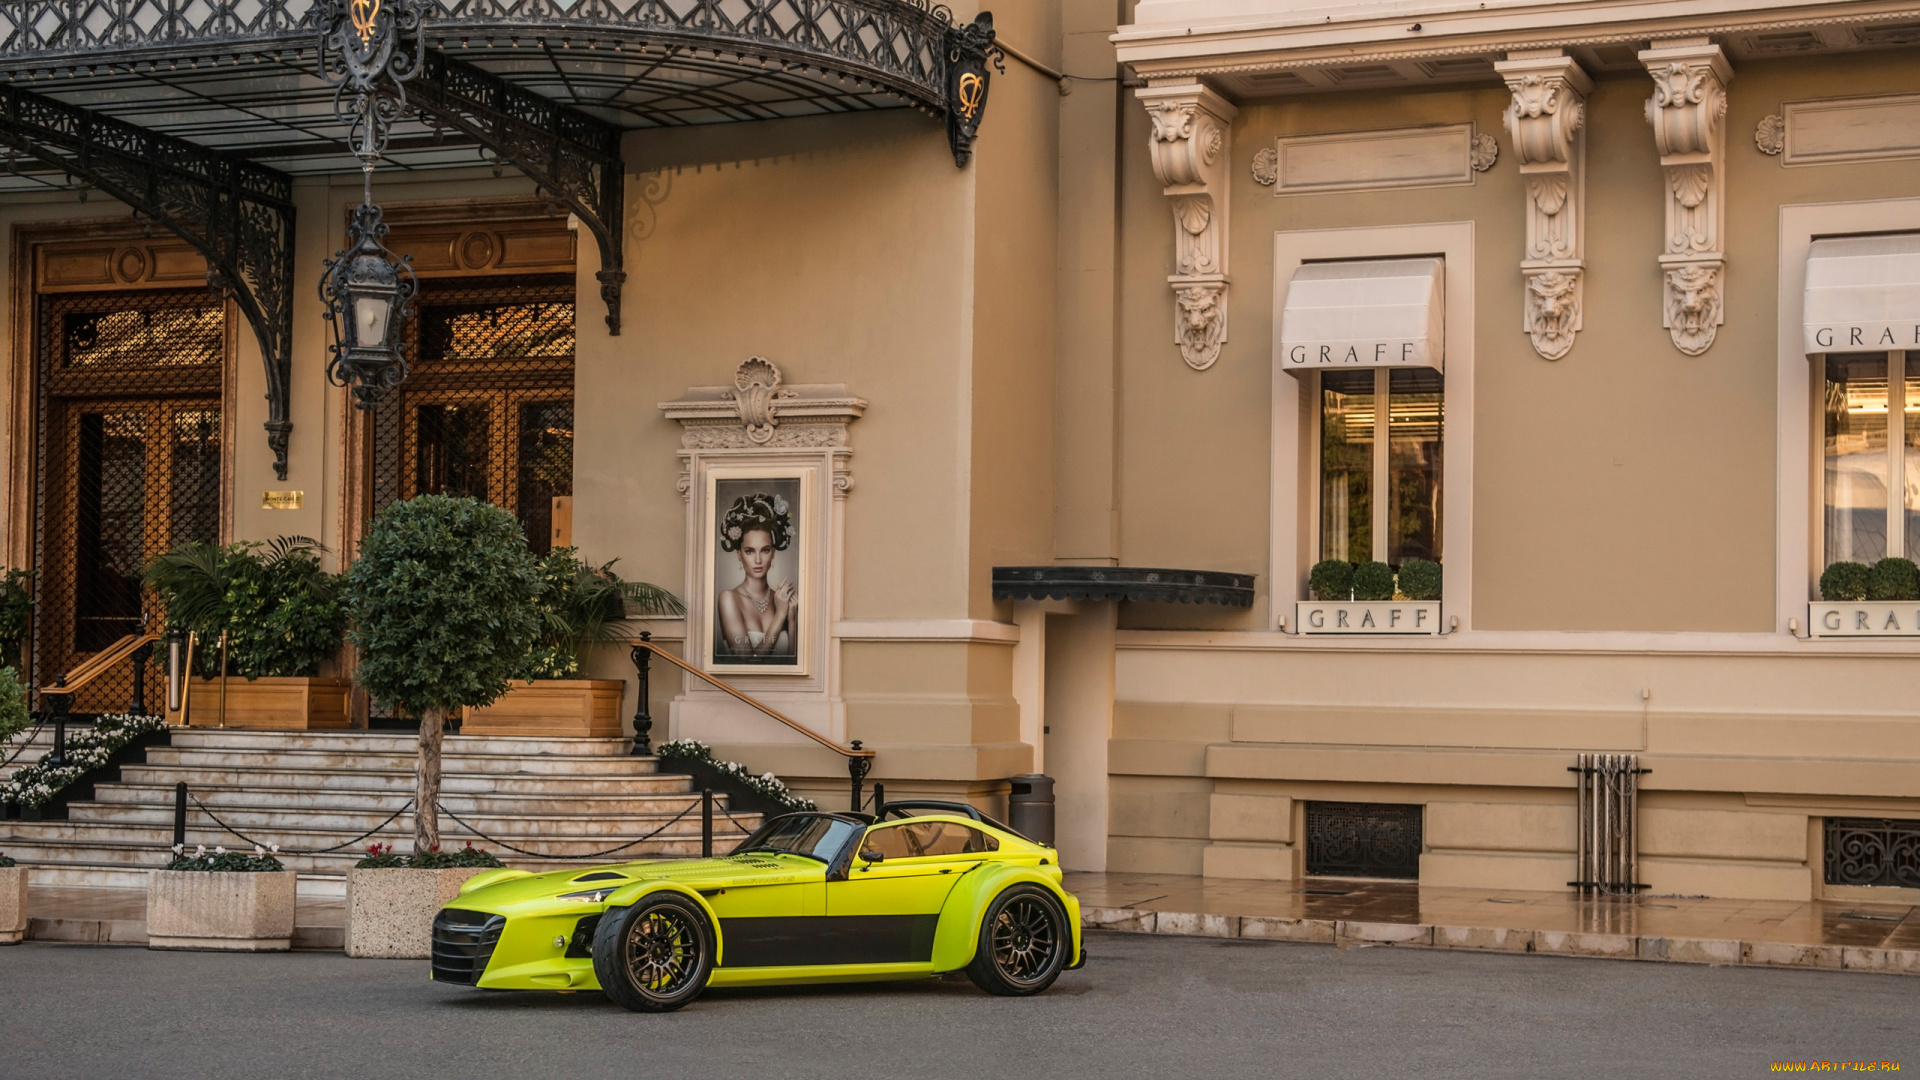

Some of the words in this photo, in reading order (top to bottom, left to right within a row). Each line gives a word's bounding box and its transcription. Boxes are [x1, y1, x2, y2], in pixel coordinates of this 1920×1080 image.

[1290, 343, 1414, 364] GRAFF
[1309, 609, 1428, 628] GRAFF
[1823, 610, 1920, 630] GRA
[734, 635, 777, 645] GRAFF
